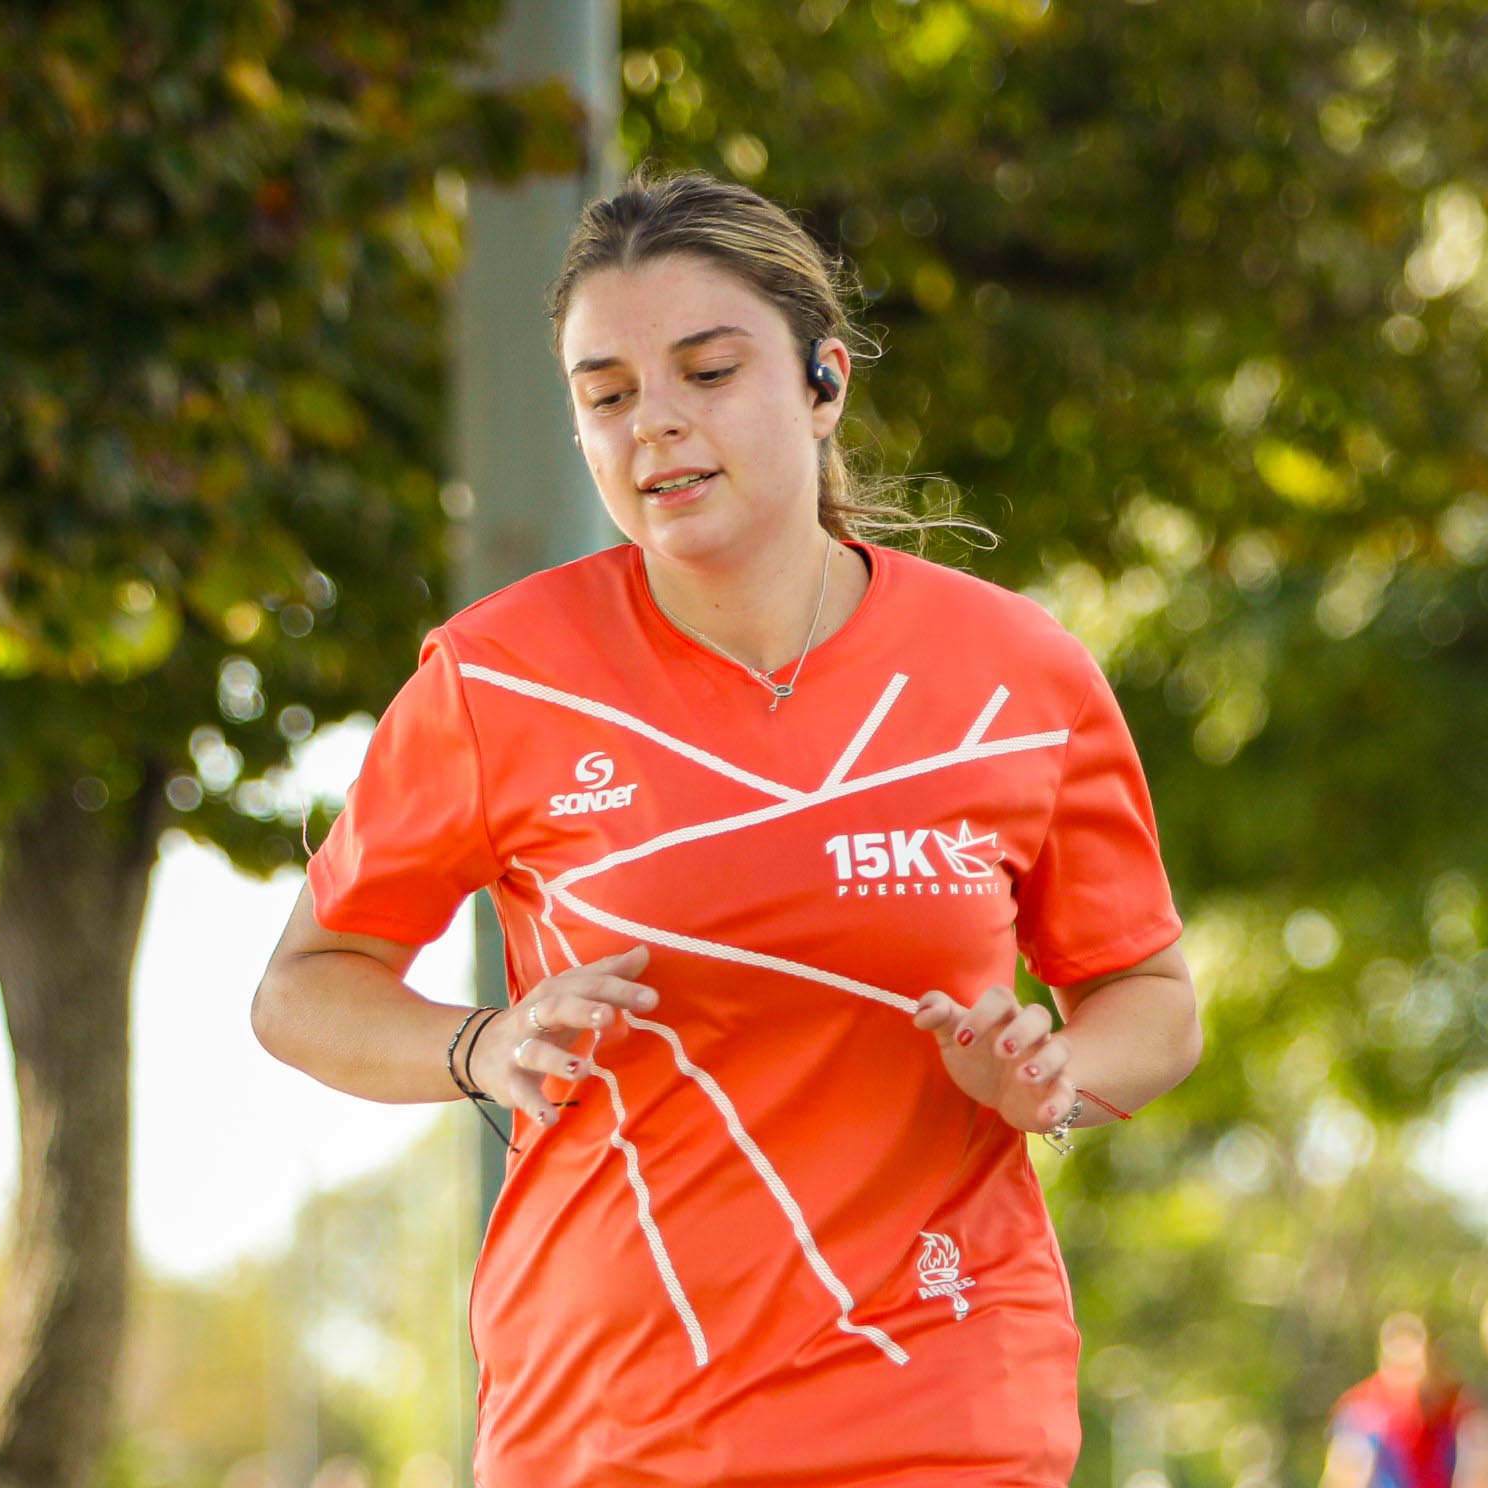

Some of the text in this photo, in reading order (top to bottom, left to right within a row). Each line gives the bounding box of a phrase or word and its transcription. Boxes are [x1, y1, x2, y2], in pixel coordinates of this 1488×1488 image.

[825, 828, 938, 880] 15K
[837, 882, 1001, 897] PUERTO NORTE
